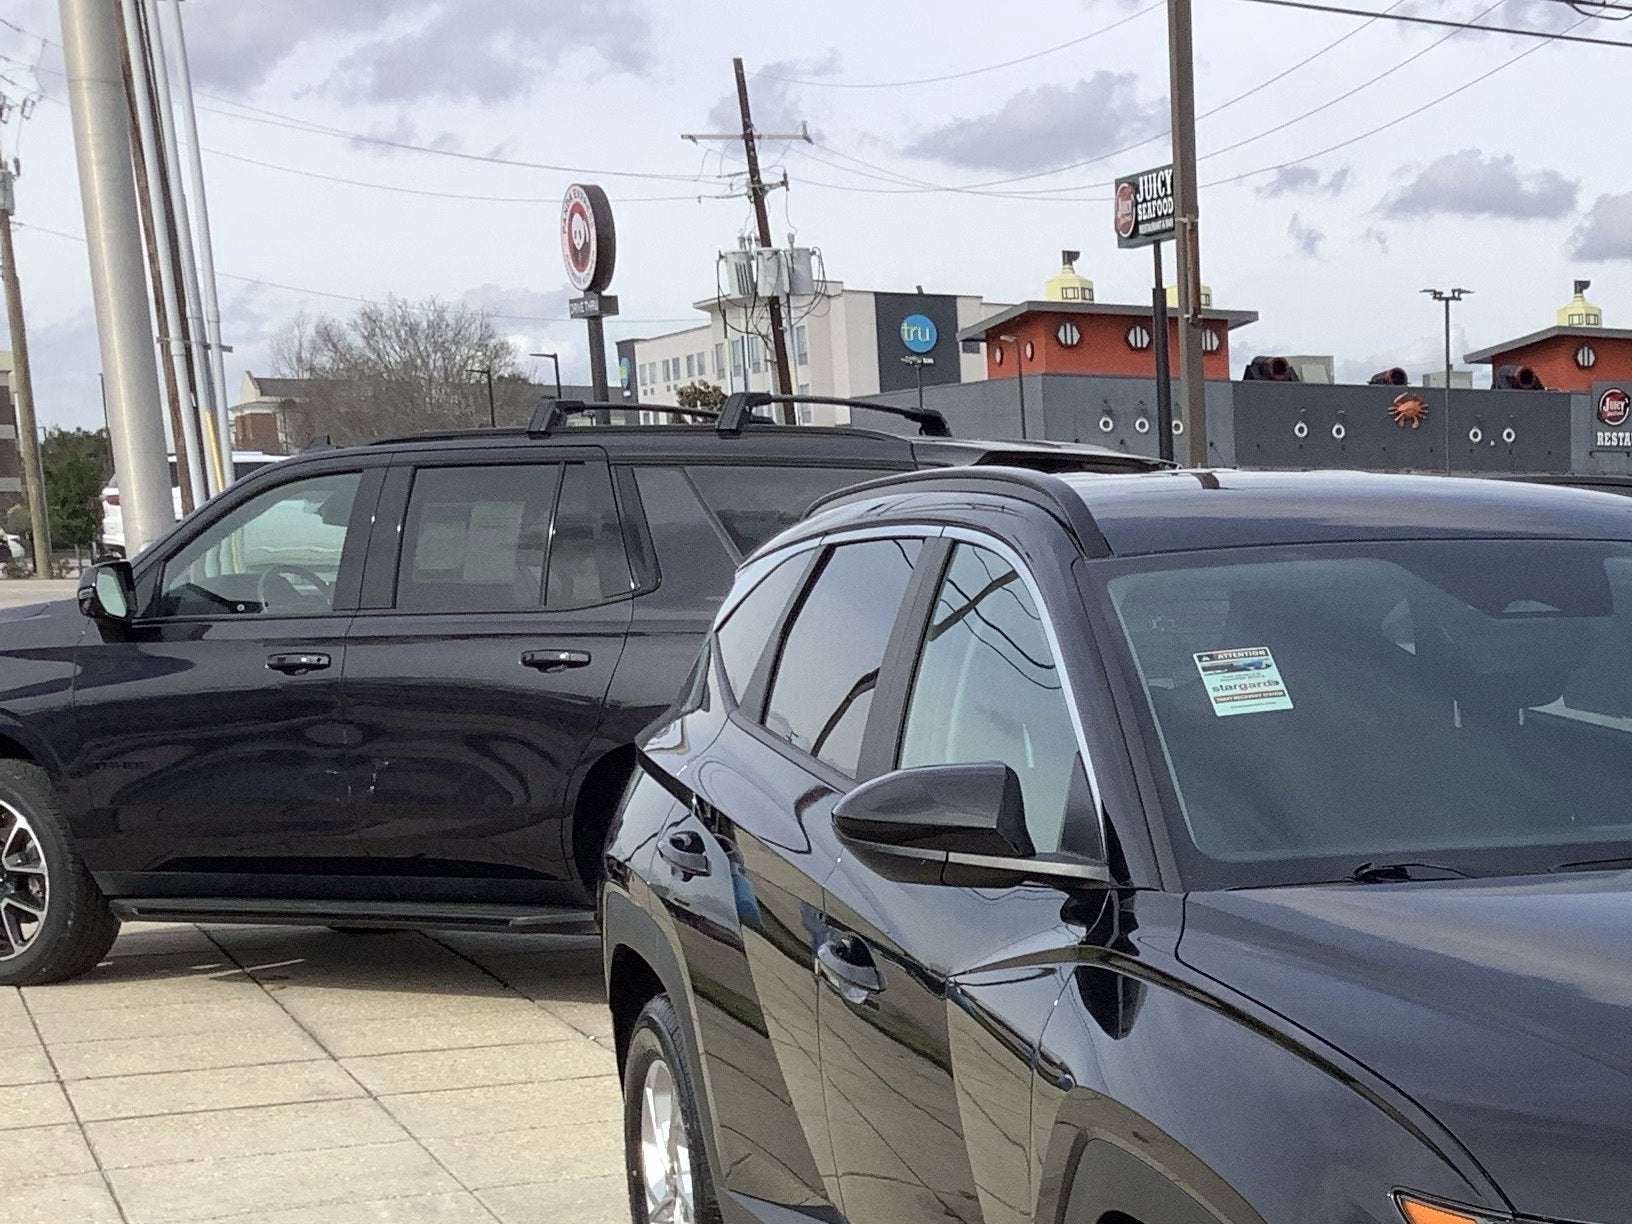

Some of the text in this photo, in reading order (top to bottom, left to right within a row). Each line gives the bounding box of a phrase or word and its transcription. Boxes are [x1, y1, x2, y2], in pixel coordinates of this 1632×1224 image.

[1136, 168, 1173, 203] JUICY
[1137, 196, 1174, 221] SEAFOOD
[901, 319, 931, 343] tru
[1217, 649, 1267, 660] ATTENTION
